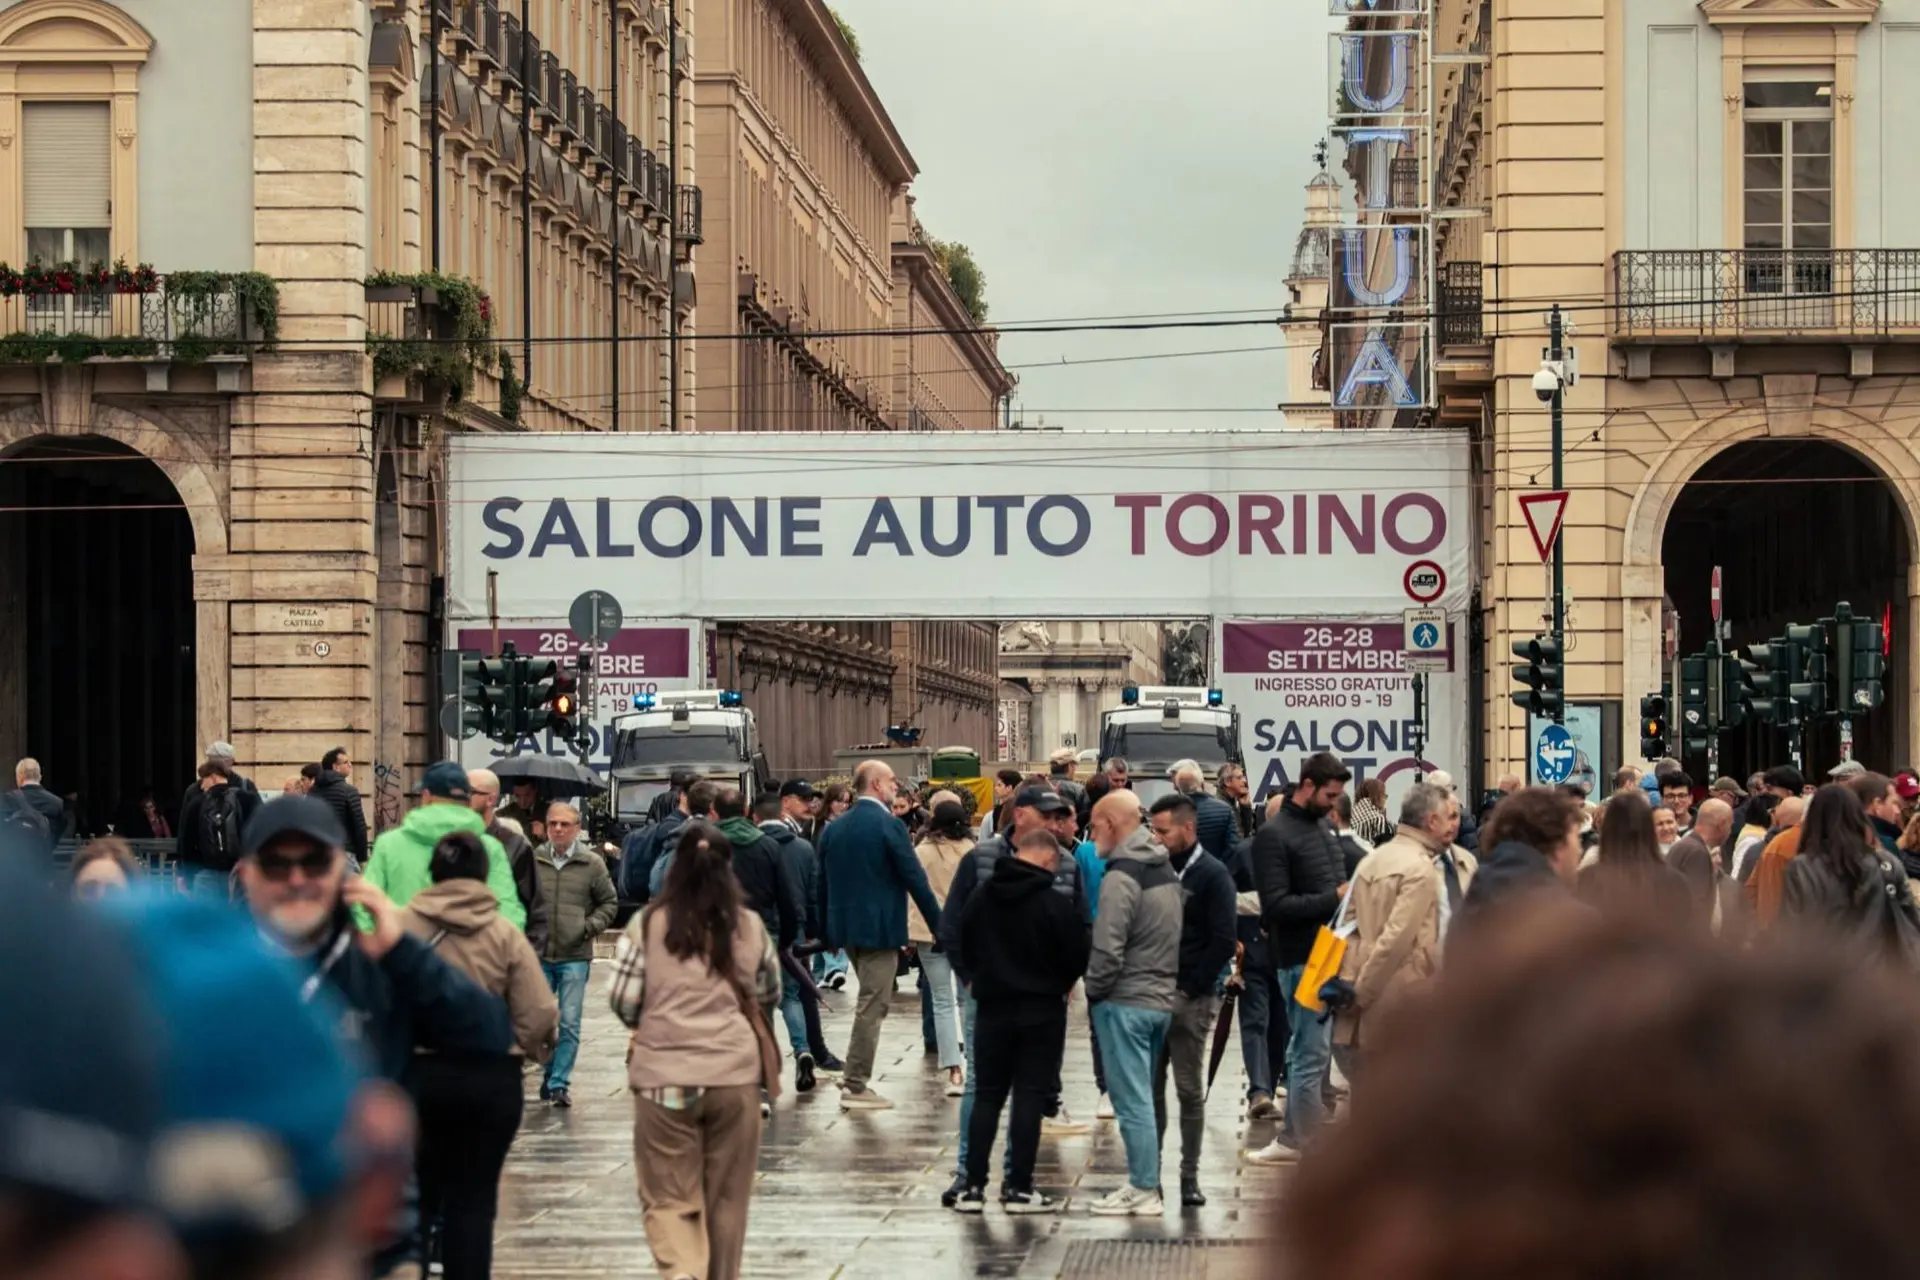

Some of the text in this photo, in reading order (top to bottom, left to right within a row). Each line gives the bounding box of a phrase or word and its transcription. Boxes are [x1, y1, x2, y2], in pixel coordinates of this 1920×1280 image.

[1331, 0, 1418, 405] UTUA
[482, 492, 1448, 559] SALONE AUTO TORINO
[289, 608, 317, 616] PIAZZA
[284, 619, 324, 627] CASTELLO
[1303, 628, 1373, 647] 26-28
[1267, 651, 1407, 670] SETTEMBRE
[577, 683, 658, 695] RATUITO
[1255, 677, 1412, 691] INGRESSO GRATUIT
[612, 699, 628, 713] 19
[1285, 694, 1346, 708] ORARIO
[1351, 694, 1361, 708] 9
[1377, 694, 1392, 708] 19
[1254, 718, 1416, 752] SALONE
